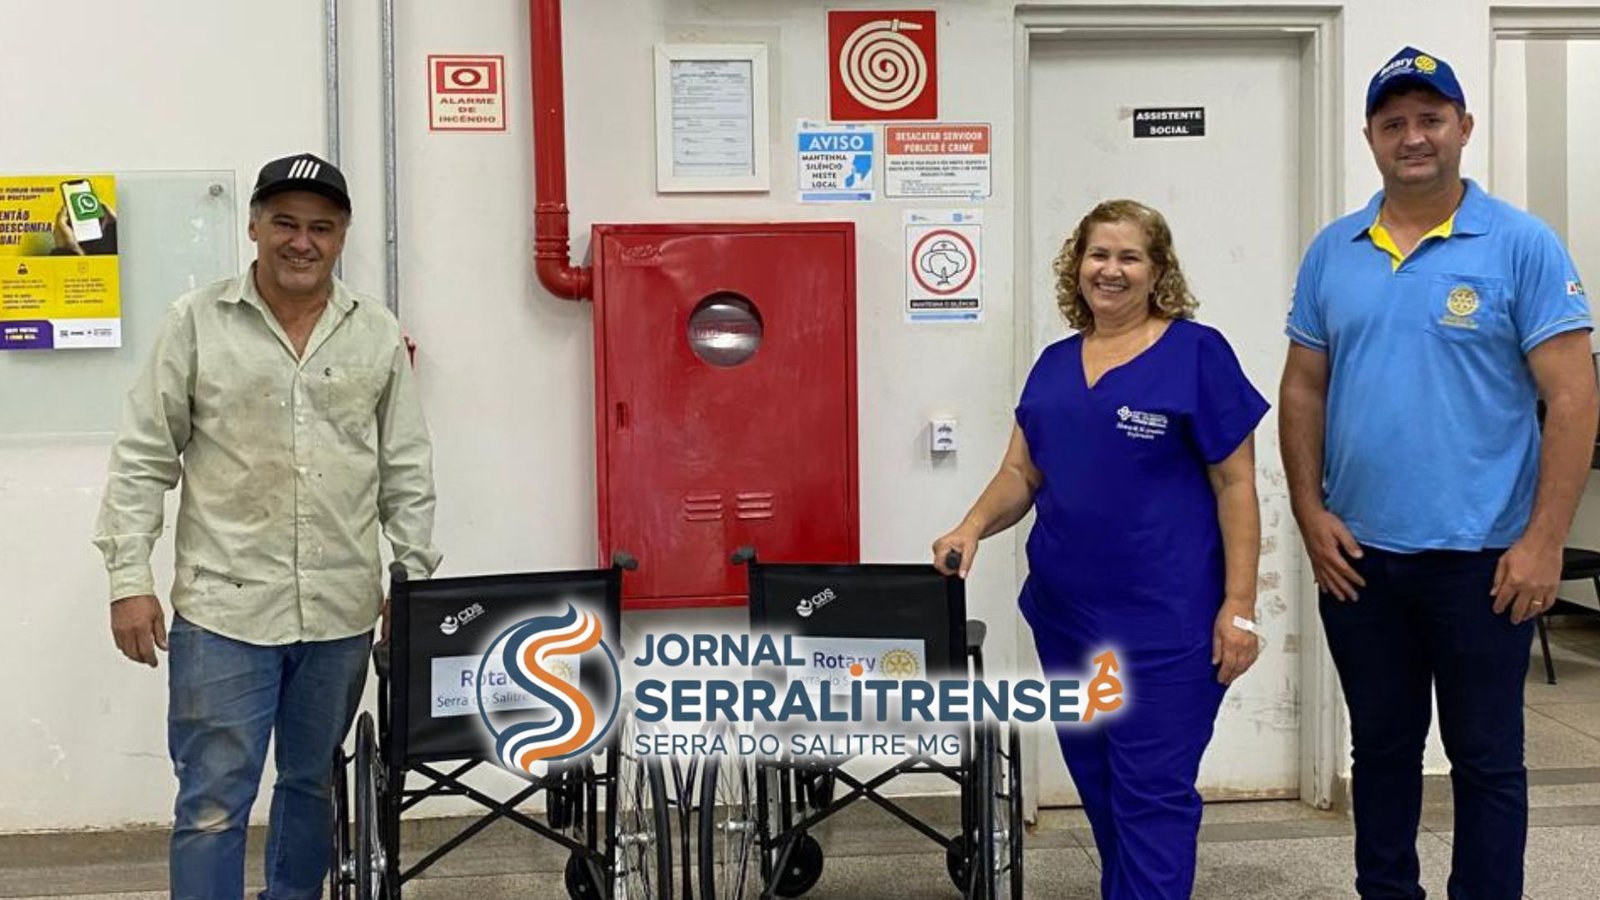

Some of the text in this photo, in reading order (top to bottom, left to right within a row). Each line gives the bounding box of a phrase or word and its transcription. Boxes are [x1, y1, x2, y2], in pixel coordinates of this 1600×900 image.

[440, 97, 495, 105] ALARME
[1136, 111, 1202, 120] ASSISTENTE
[1150, 126, 1189, 135] SOCIAL
[895, 131, 982, 141] DESACATAR SERVIDOR
[809, 135, 864, 150] AVISO
[948, 143, 973, 153] CRIME
[812, 181, 837, 189] LOCAL
[812, 588, 834, 605] CDS
[437, 695, 469, 707] Serra
